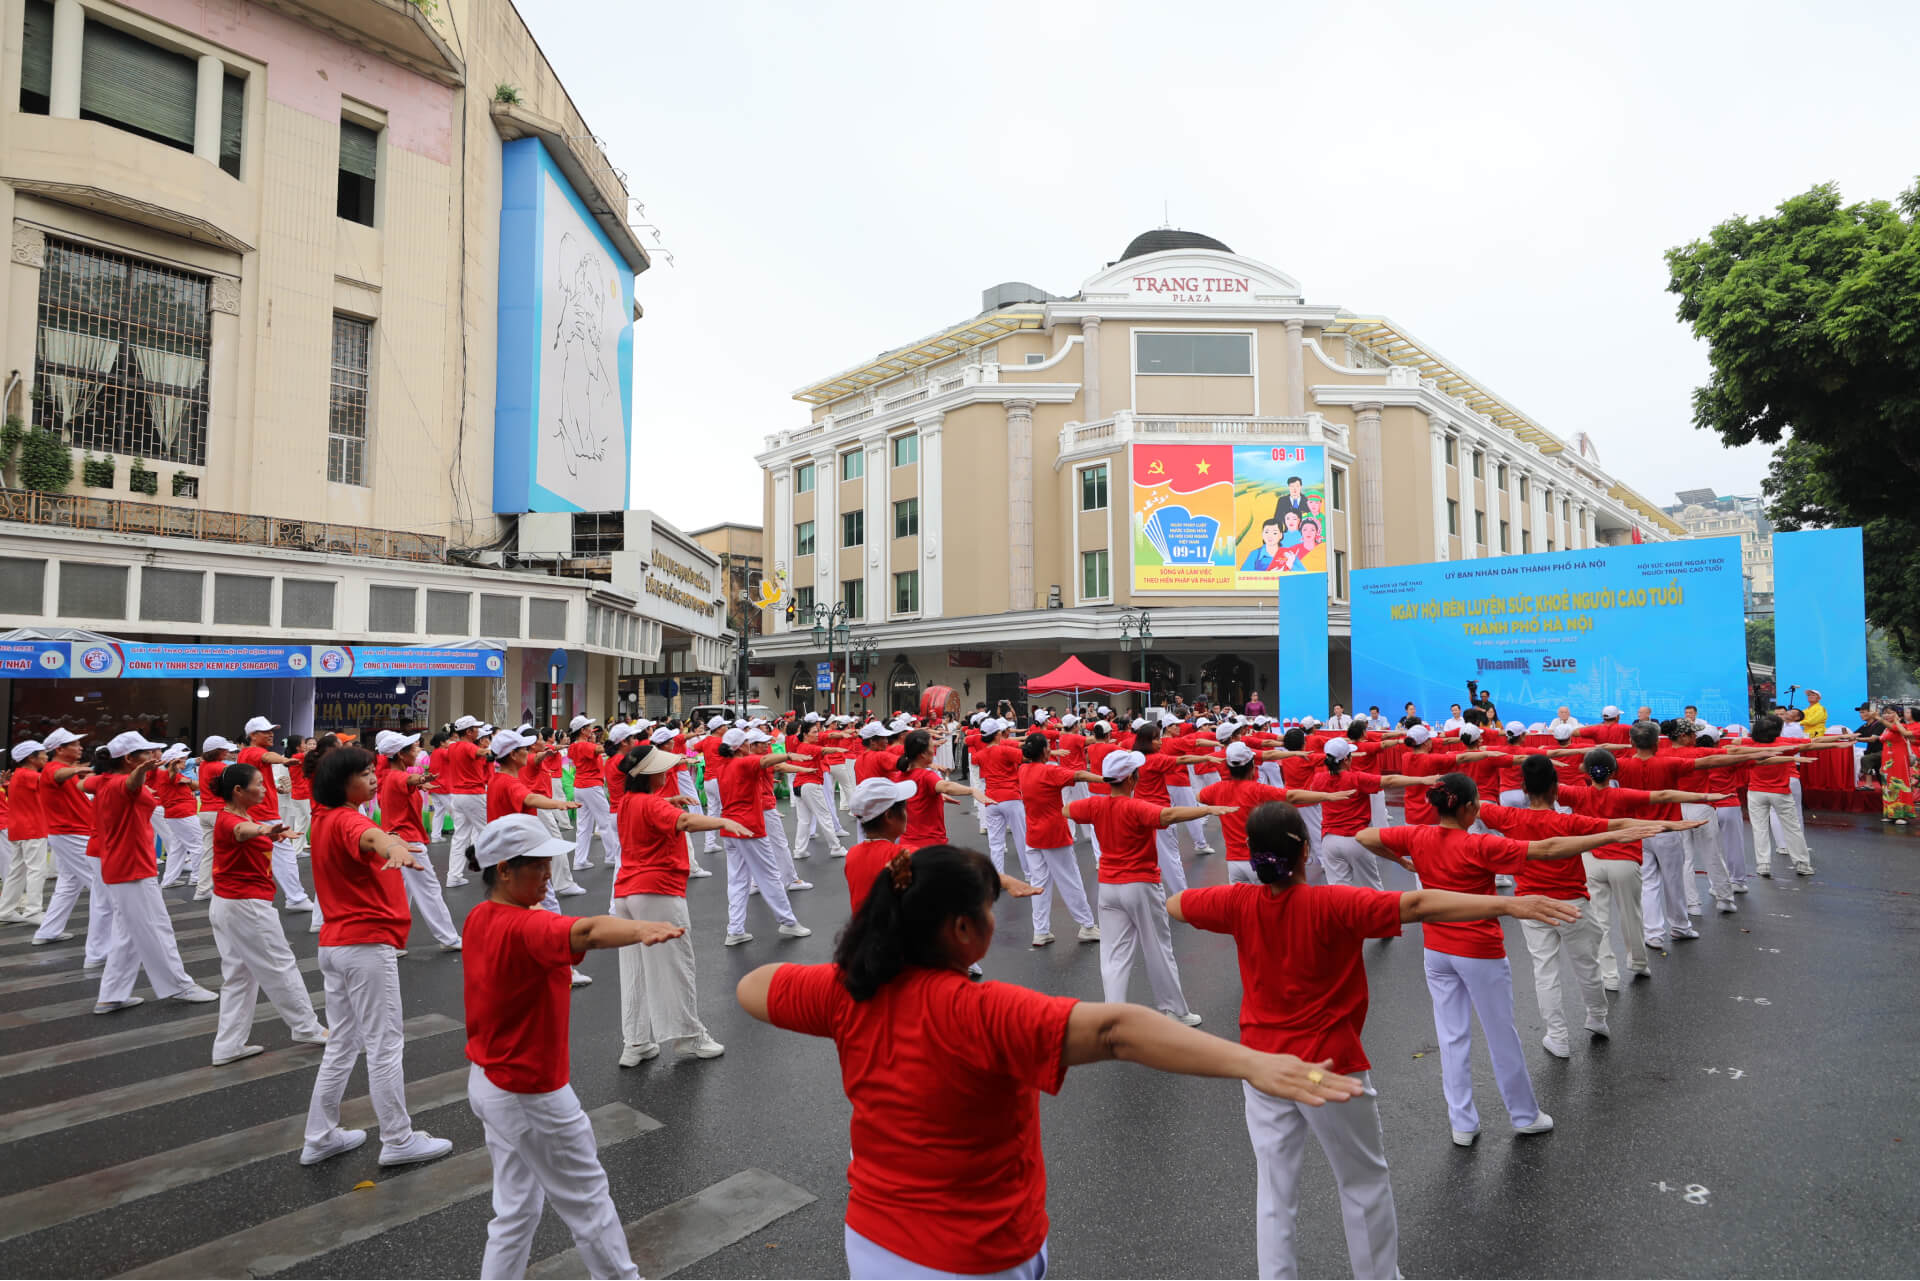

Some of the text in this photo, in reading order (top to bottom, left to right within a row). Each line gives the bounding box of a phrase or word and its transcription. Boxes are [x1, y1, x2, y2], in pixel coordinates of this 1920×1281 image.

[1133, 277, 1249, 294] TRANG TIEN
[1173, 294, 1211, 303] PLAZA
[1173, 546, 1207, 558] 09-11
[1457, 570, 1474, 579] BAN
[1475, 568, 1499, 578] NHÂN
[1501, 566, 1518, 576] DÂN
[1520, 563, 1551, 574] THÀNH
[1553, 561, 1572, 572] PHỐ
[1574, 560, 1587, 570] HÀ
[1589, 559, 1606, 570] NỘI
[1391, 600, 1420, 620] NGÀY
[1421, 598, 1441, 623] HỘI
[1443, 597, 1466, 618] RÈN
[1468, 594, 1506, 620] LUYỆN
[1508, 592, 1534, 615] SỨC
[1573, 586, 1615, 610] NGƯỜI
[1617, 588, 1647, 608] CAO
[1648, 577, 1684, 606] TUỔI
[1462, 614, 1594, 636] THÀNH PHỐ HÀ NỘI
[6, 658, 32, 670] NHẬT
[47, 656, 56, 664] 11
[129, 660, 152, 670] CÔNG
[154, 662, 164, 670] TY
[166, 662, 187, 670] TNHH
[206, 662, 223, 670] KEM
[294, 658, 302, 666] 12
[363, 661, 381, 670] CÔNG
[429, 663, 476, 671] COMMUNICATION
[1476, 657, 1529, 670] Vinamilk
[1542, 656, 1576, 668] Sure
[323, 700, 343, 721] HÀ
[347, 700, 371, 721] NỘI
